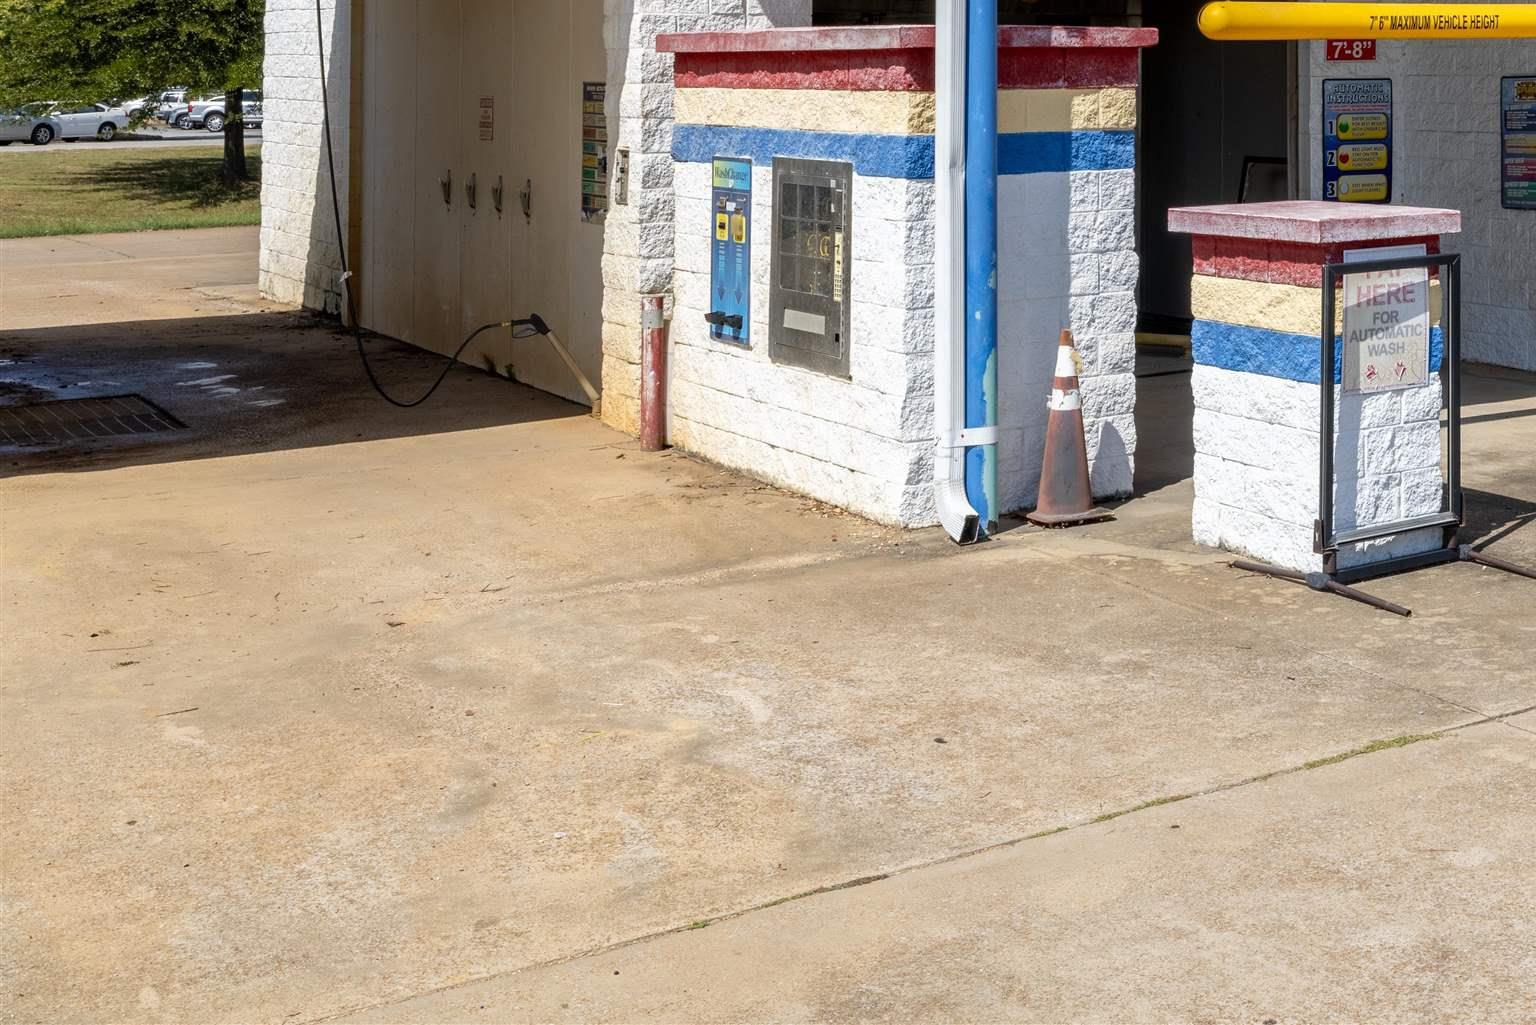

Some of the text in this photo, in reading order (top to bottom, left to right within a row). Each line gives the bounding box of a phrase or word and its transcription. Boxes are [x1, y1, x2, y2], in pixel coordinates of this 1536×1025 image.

[1390, 15, 1431, 30] MAXIMUM
[1433, 15, 1468, 29] VEHICLE
[1469, 14, 1500, 29] HEIGHT
[1334, 83, 1383, 94] AUTOMATIC
[1327, 95, 1389, 104] INSTRUCTIONS
[1328, 120, 1333, 134] 1
[1328, 151, 1334, 165] 2
[1328, 182, 1335, 196] 3
[1357, 282, 1415, 307] HERE
[1373, 311, 1400, 325] FOR
[1350, 324, 1422, 343] AUTOMATIC
[1367, 342, 1406, 356] WASH
